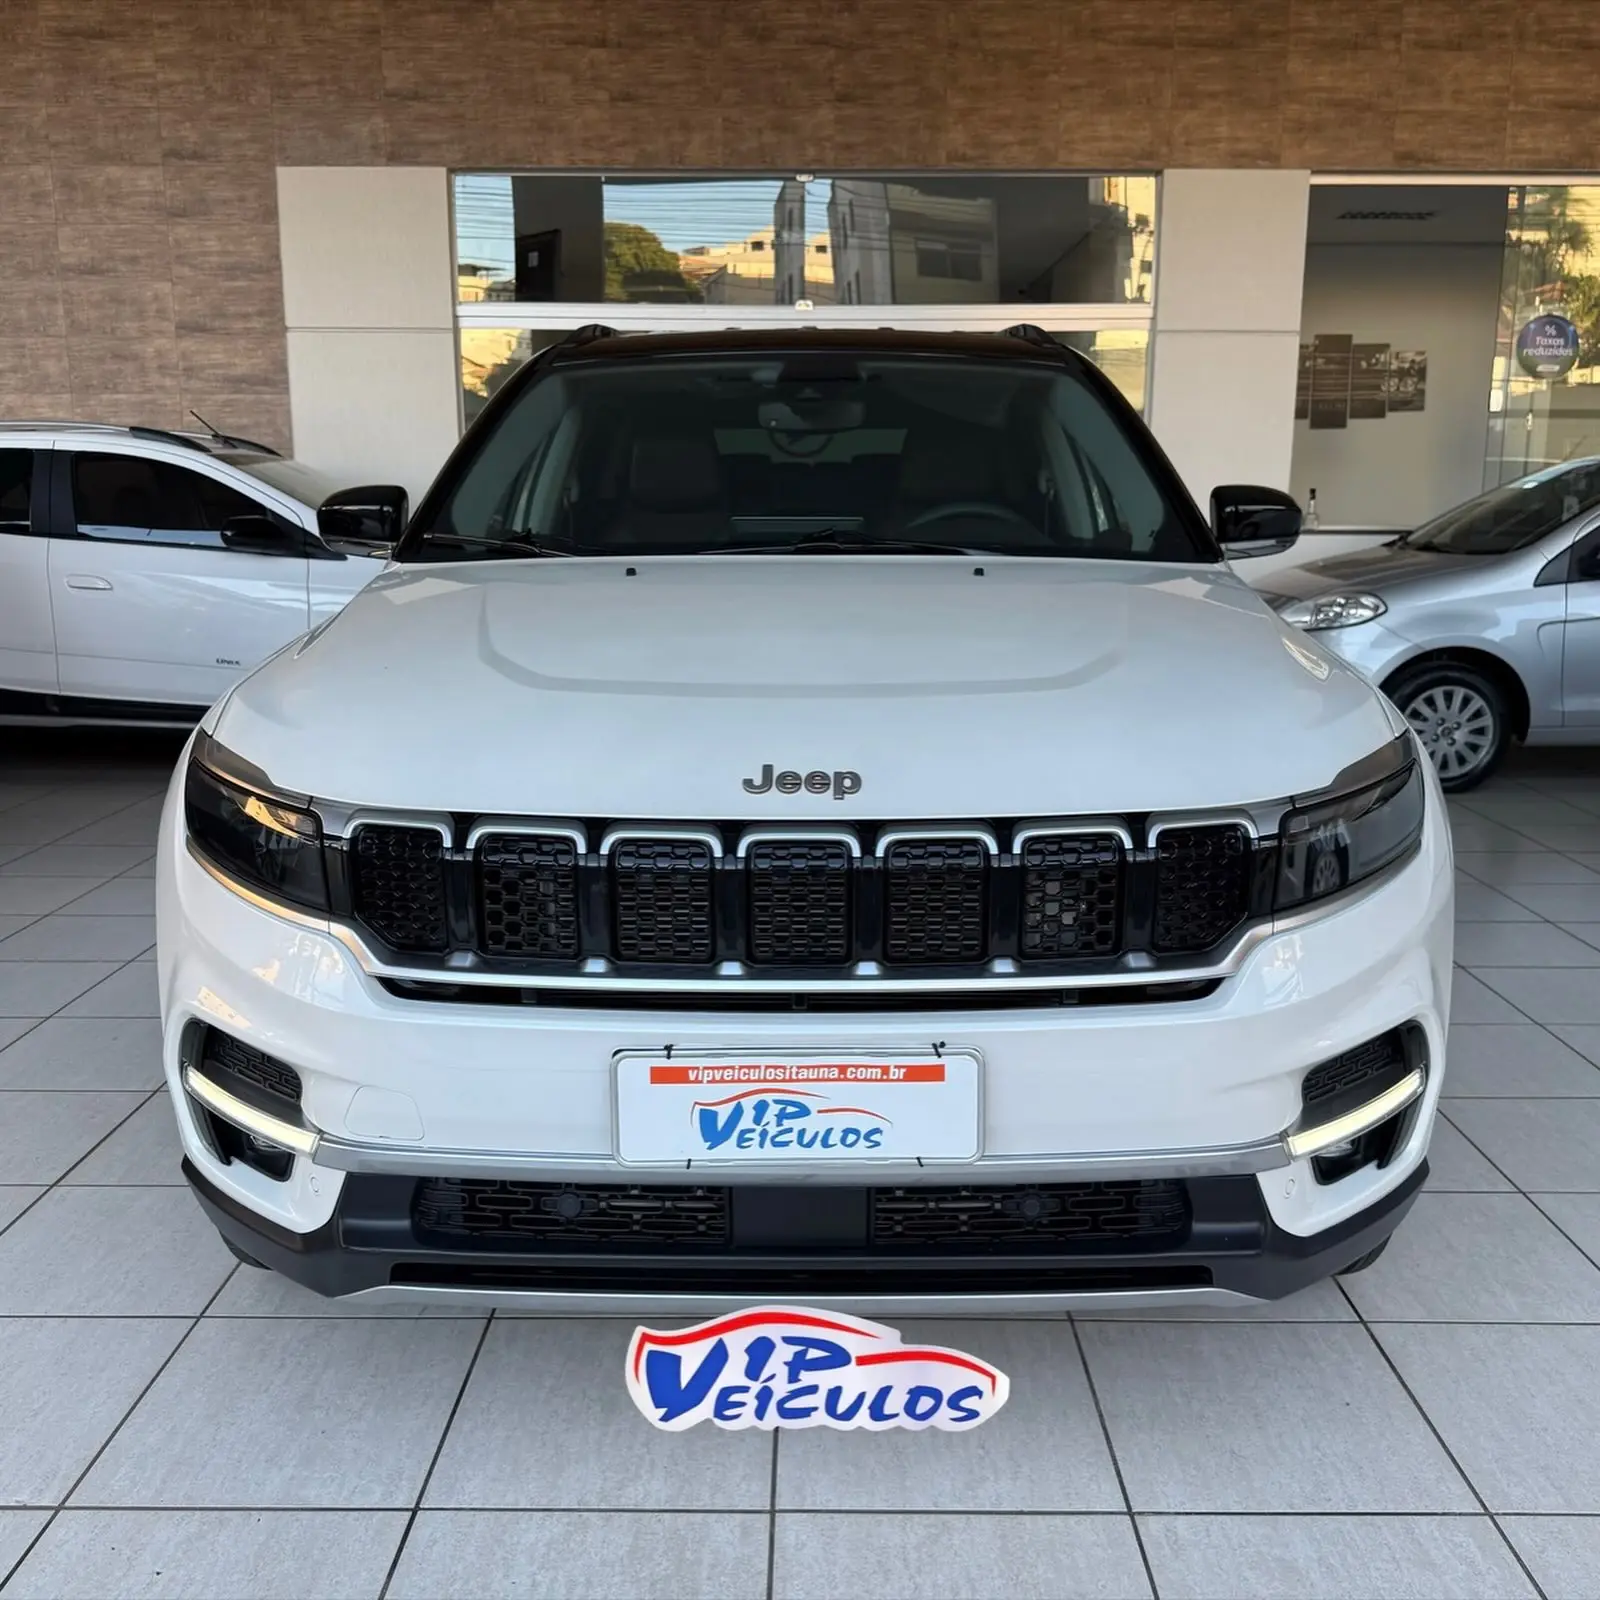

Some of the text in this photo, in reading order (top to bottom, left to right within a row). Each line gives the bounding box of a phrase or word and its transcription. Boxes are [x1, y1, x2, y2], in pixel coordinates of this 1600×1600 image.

[1523, 346, 1573, 357] reduzidas
[1535, 336, 1565, 346] Taxas
[742, 763, 862, 801] Jeep
[687, 1066, 907, 1083] vipveiculositauna.com.br
[699, 1099, 812, 1150] VIP
[646, 1336, 852, 1422] VIP
